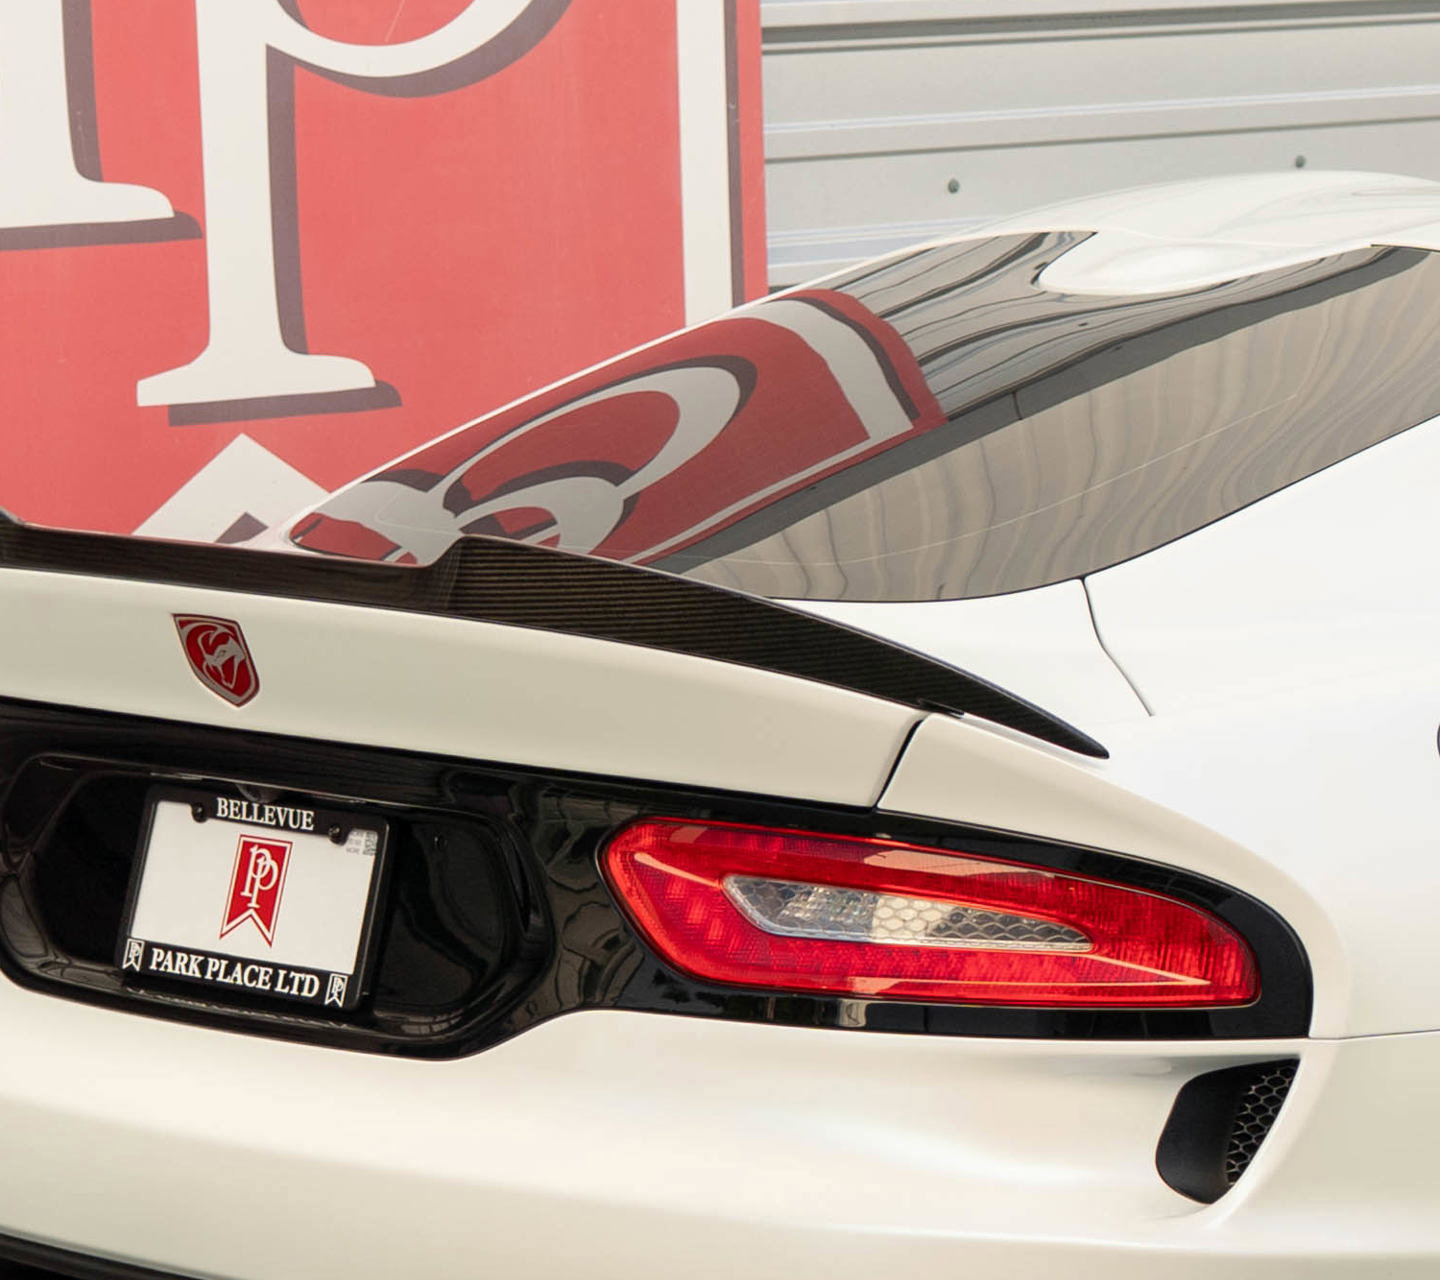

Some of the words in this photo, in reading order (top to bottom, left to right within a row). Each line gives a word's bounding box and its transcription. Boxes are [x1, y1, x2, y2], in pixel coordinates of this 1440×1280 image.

[216, 797, 315, 831] BELLEVUE
[150, 947, 205, 979] PARK
[205, 957, 272, 990] PLACE
[274, 970, 321, 998] LTD
